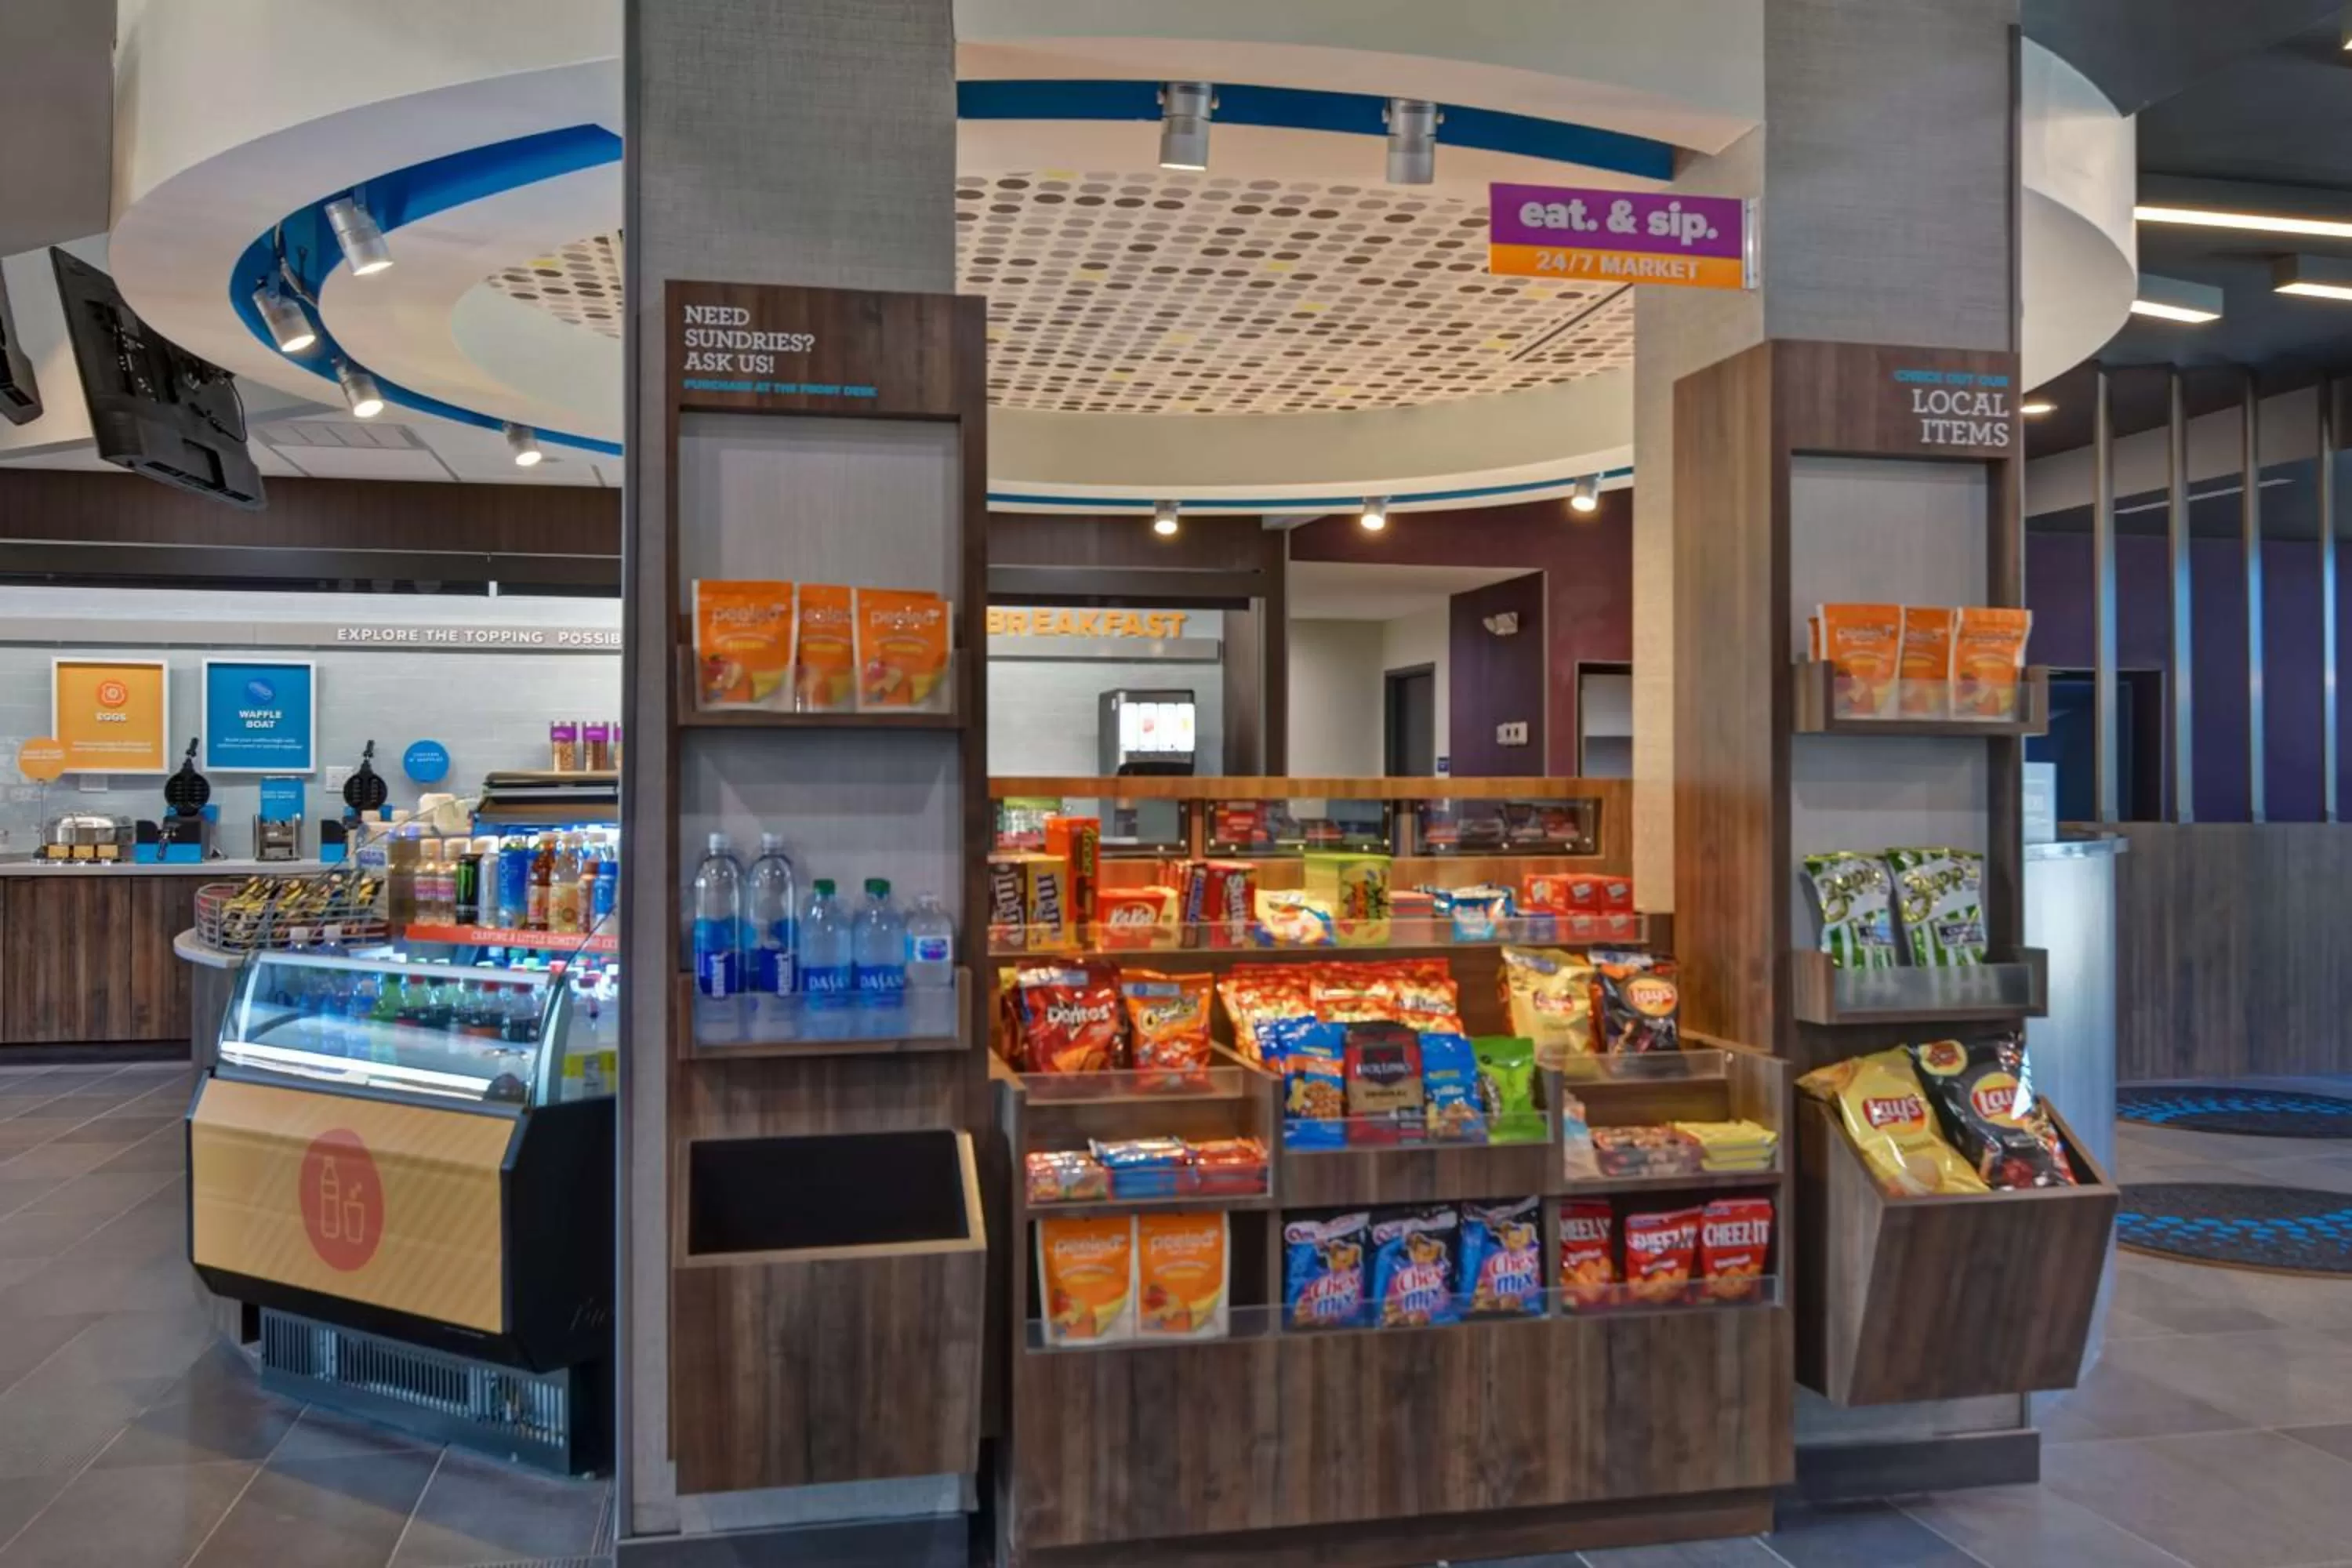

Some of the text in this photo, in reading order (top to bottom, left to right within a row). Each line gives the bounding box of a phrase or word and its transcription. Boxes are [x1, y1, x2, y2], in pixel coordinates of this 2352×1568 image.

[1519, 198, 1719, 246] eat. & sip.
[1536, 250, 1701, 279] 24/7 MARKET
[684, 305, 750, 325] NEED
[684, 328, 815, 352] SUNDRIES?
[684, 352, 775, 374] ASK US!
[1911, 388, 2010, 418] LOCAL
[1920, 419, 2010, 448] ITEMS
[337, 628, 419, 641] EXPLORE
[426, 630, 459, 643] THE
[464, 630, 544, 644] TOPPING
[986, 609, 1189, 639] BREAKFAST
[238, 710, 282, 719] WAFFLE
[245, 720, 275, 728] BOAT
